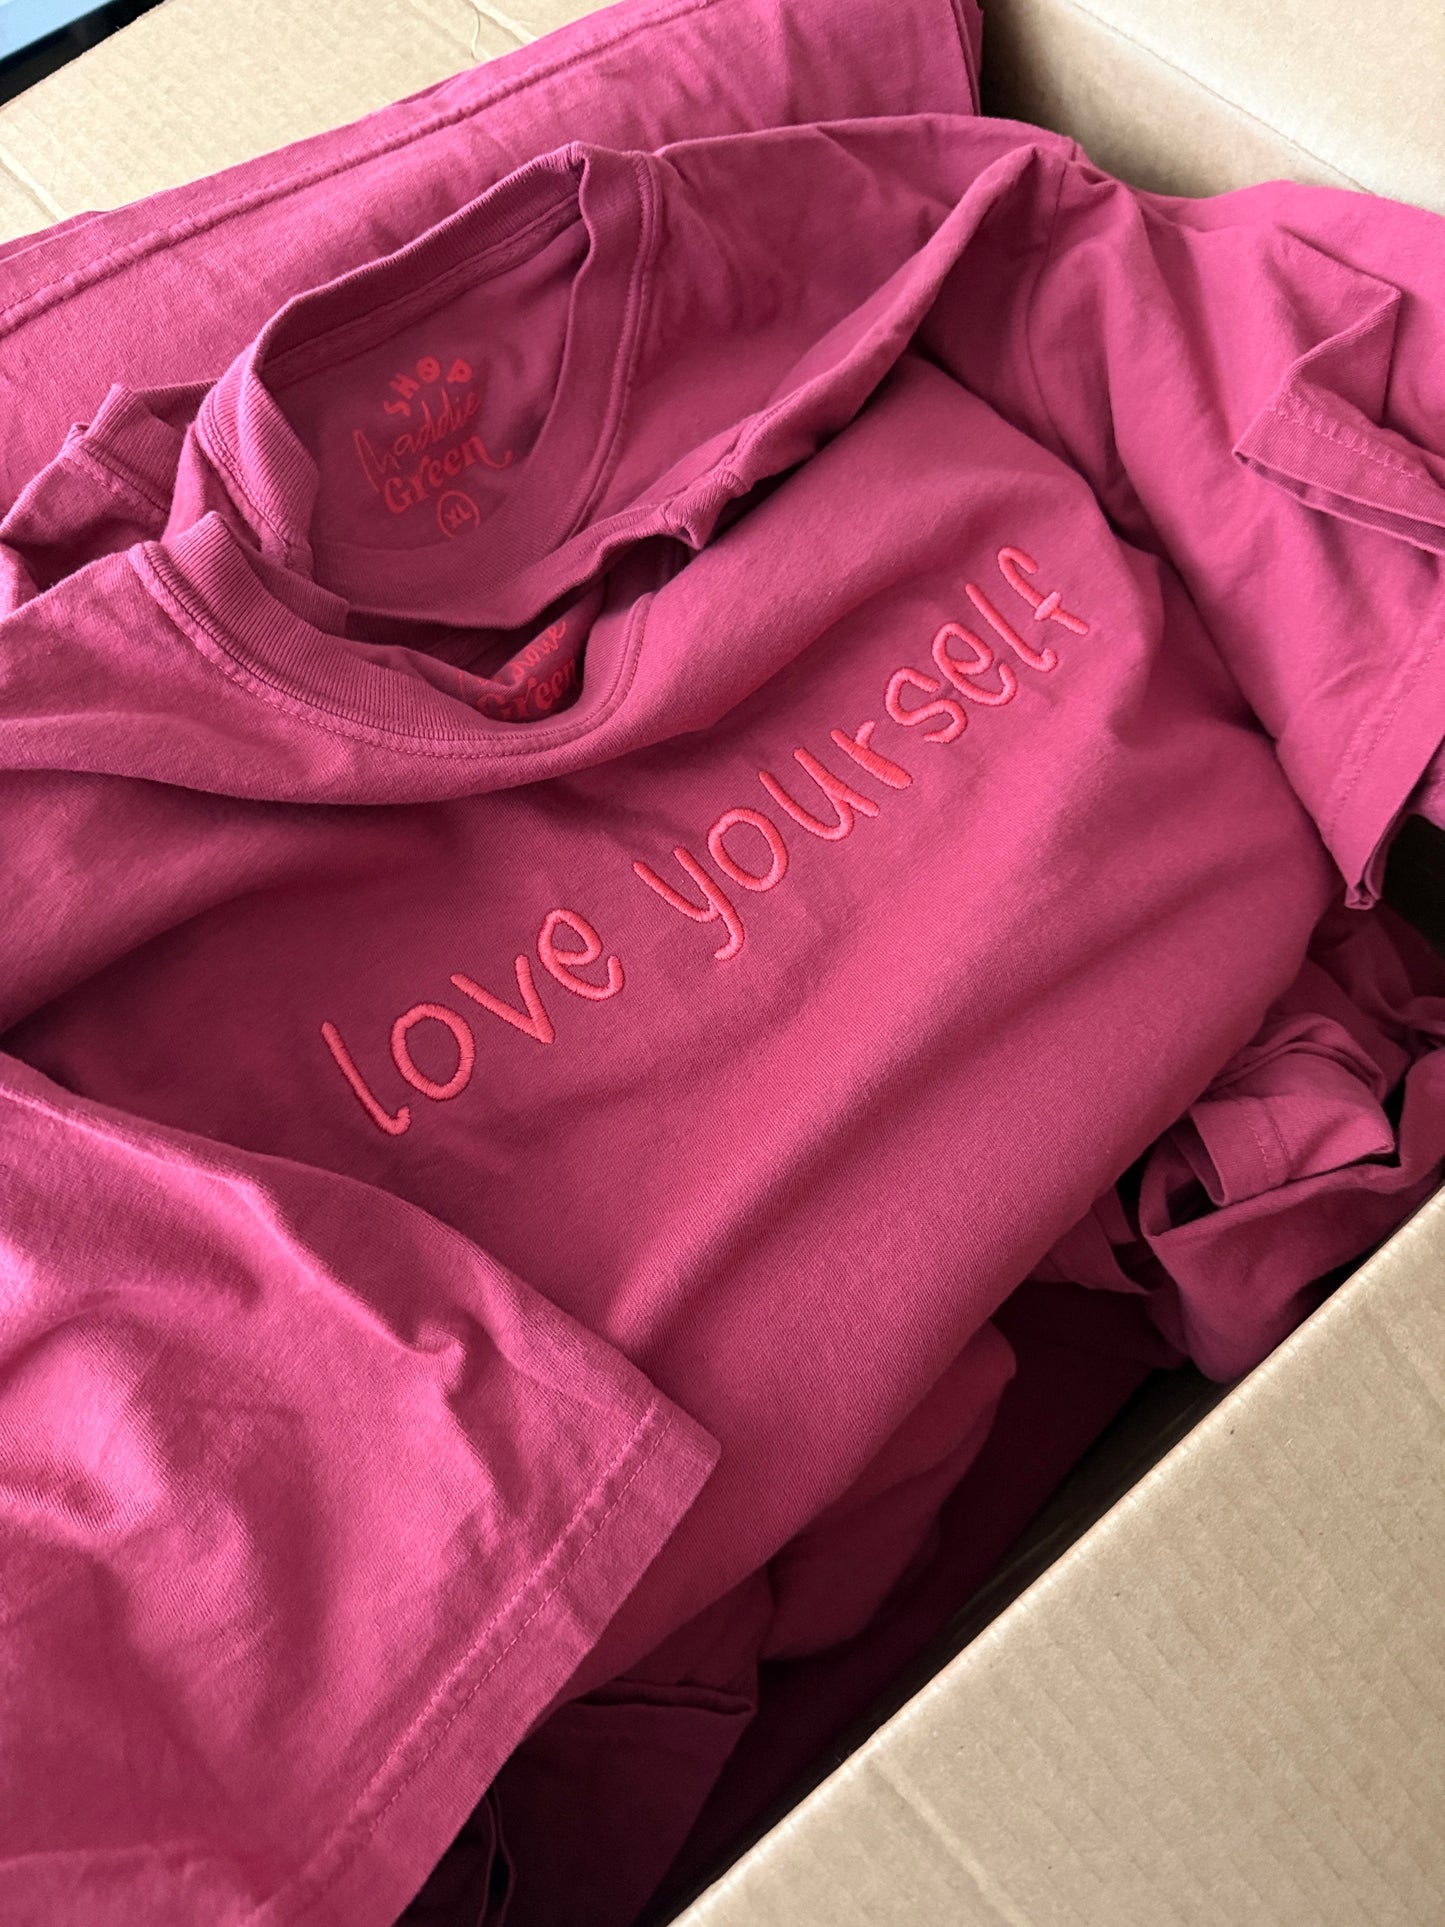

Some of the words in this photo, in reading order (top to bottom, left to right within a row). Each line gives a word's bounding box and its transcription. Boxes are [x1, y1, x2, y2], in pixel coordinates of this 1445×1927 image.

[383, 356, 473, 417] SHOP
[384, 435, 513, 513] Green
[446, 503, 472, 528] XL
[320, 907, 625, 1136] love
[632, 546, 1089, 961] yourself
